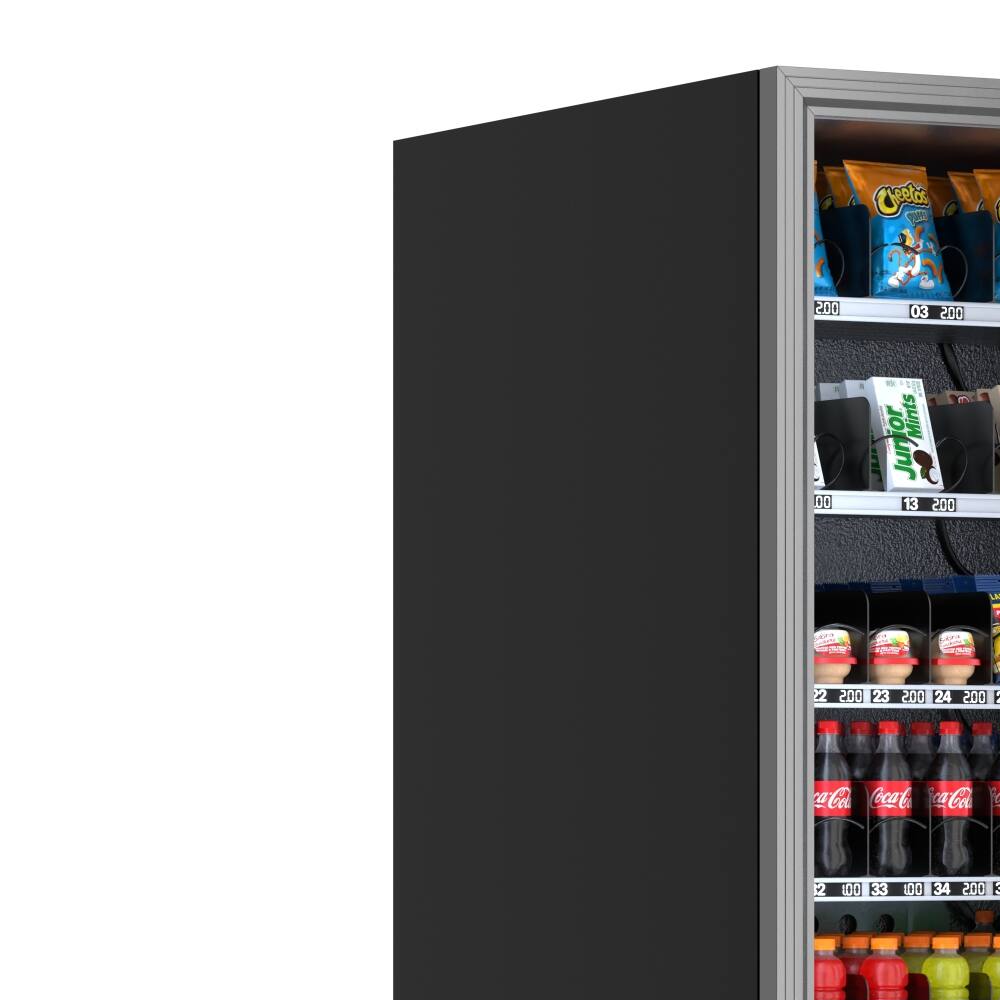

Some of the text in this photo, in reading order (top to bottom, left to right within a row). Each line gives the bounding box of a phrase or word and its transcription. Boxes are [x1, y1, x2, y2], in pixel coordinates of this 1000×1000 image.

[875, 182, 929, 216] Cheetos
[911, 305, 928, 318] 03
[902, 393, 923, 439] Mints
[904, 498, 918, 511] 13
[873, 689, 890, 702] 23
[934, 690, 952, 703] 24
[872, 883, 888, 895] 33
[933, 882, 950, 895] 34
